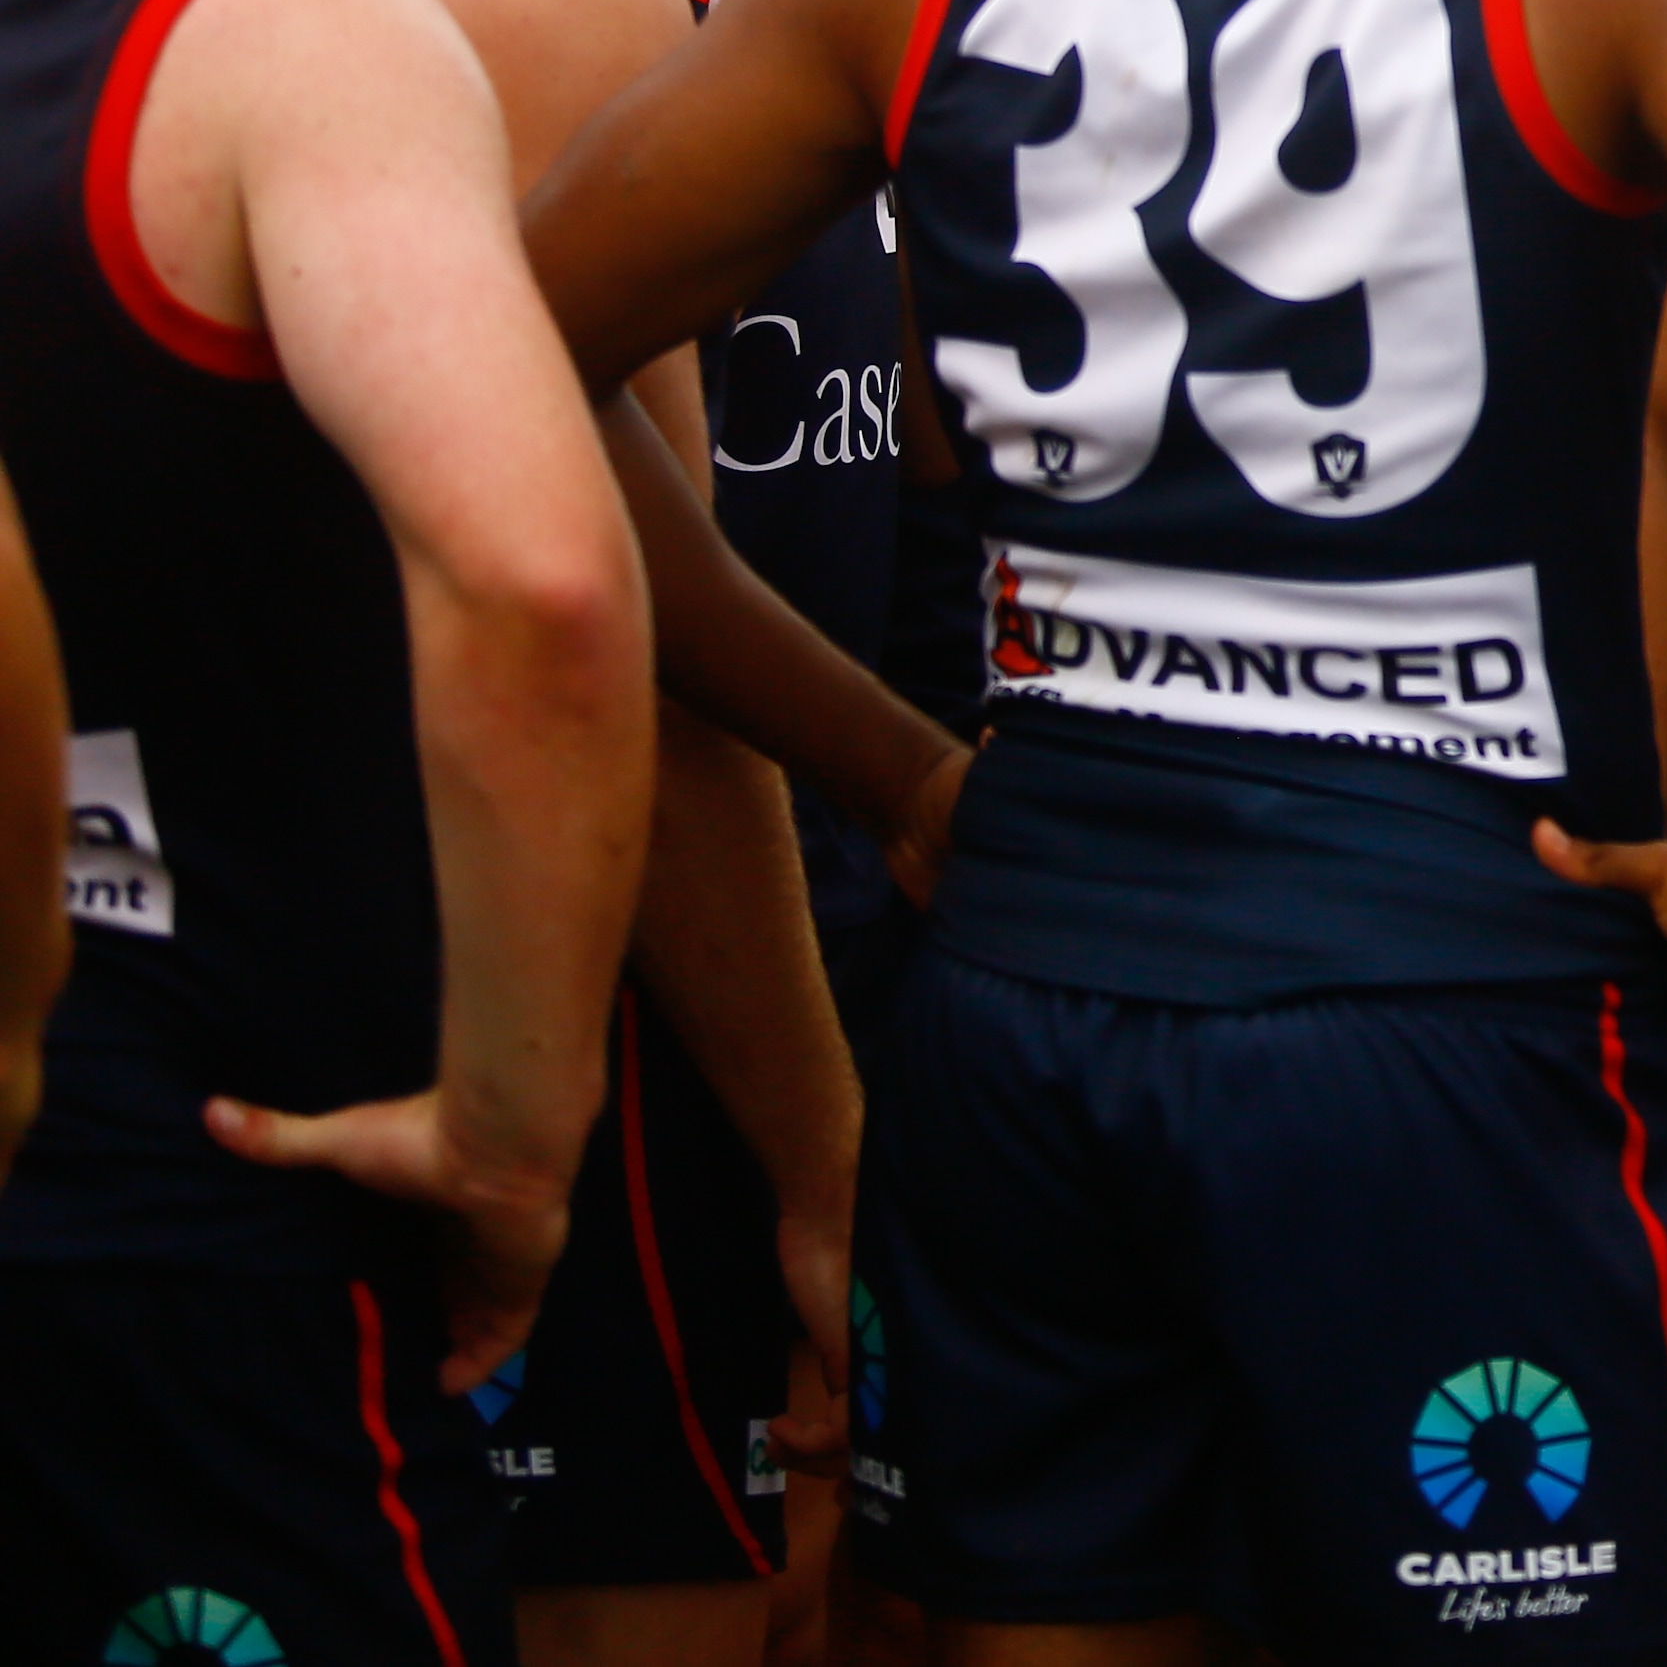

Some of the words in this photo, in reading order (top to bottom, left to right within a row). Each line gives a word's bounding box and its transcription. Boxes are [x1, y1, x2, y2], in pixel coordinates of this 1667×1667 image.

[713, 314, 902, 472] Case
[992, 596, 1525, 704] ADVANCED
[1397, 1541, 1617, 1586] CARLISLE
[1439, 1588, 1508, 1633] Life's
[1515, 1588, 1590, 1620] better
